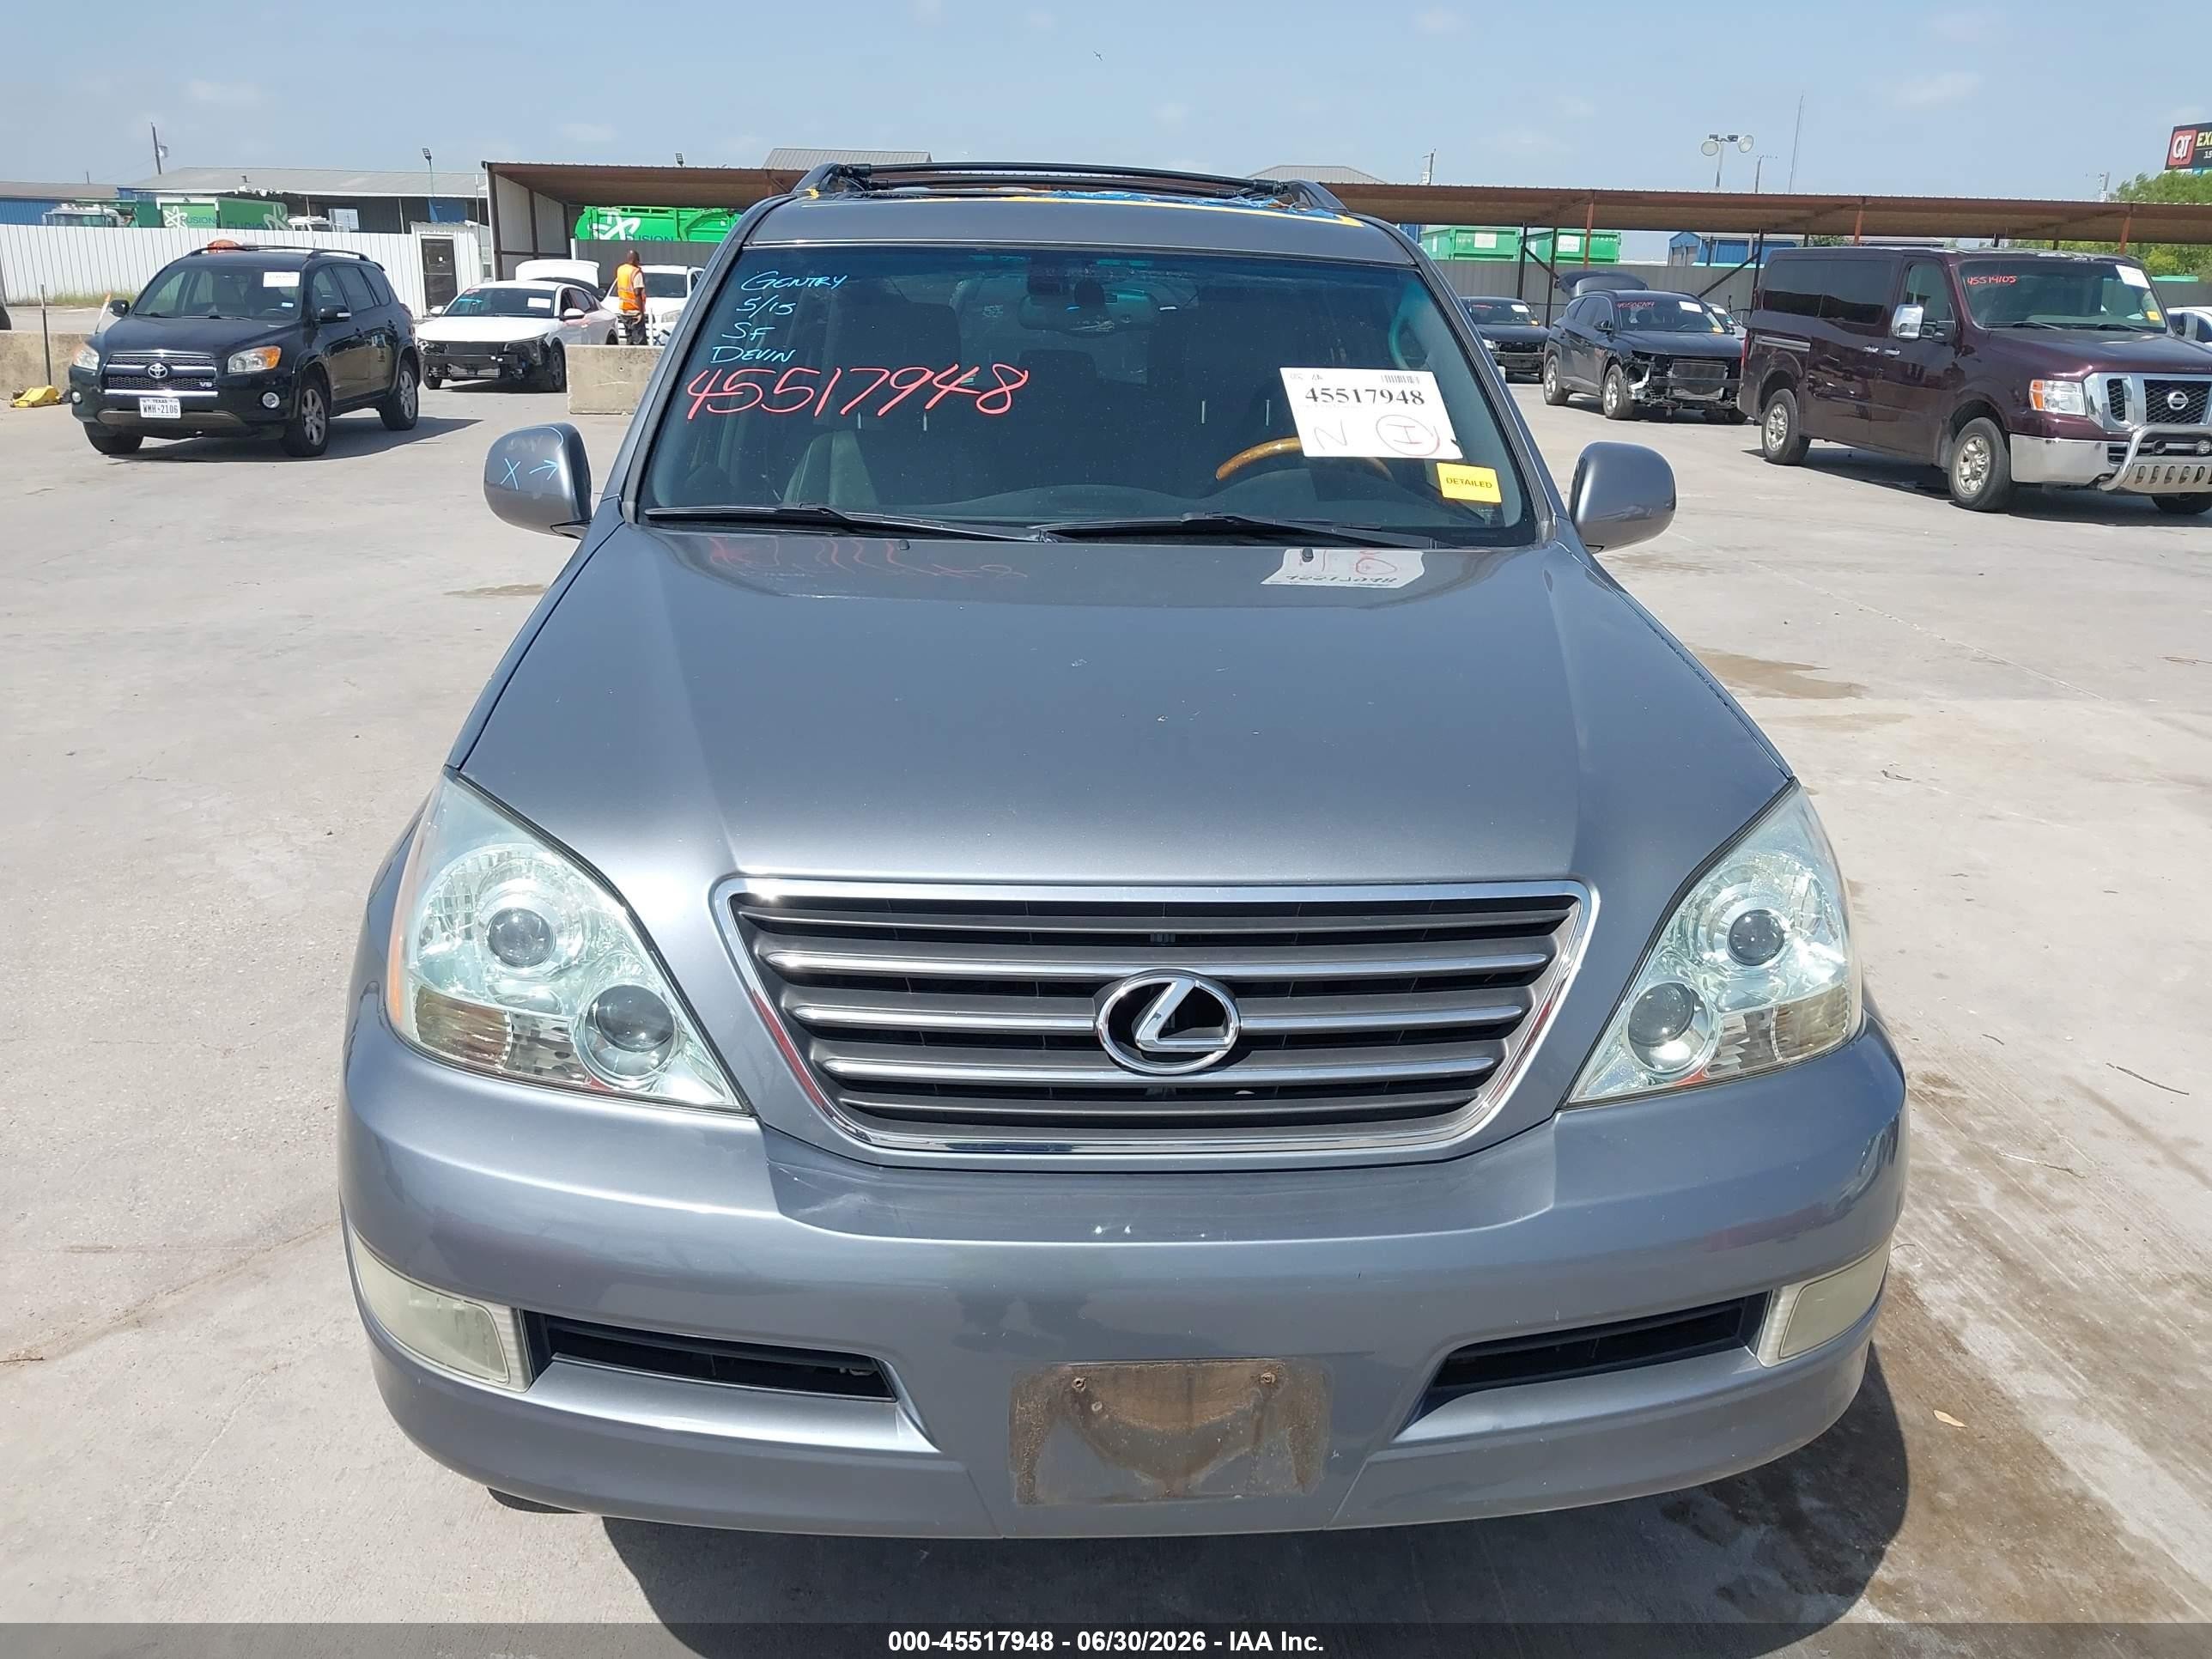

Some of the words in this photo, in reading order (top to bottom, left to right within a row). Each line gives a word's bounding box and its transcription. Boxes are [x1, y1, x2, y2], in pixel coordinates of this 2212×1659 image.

[2173, 135, 2192, 161] QT
[741, 270, 848, 291] GENTRY
[736, 295, 797, 319] 5/15
[721, 322, 776, 341] SF
[710, 346, 797, 363] DEVIN
[687, 363, 1030, 420] 45517948
[1304, 387, 1425, 406] 45517948
[1446, 477, 1493, 489] DETAILED
